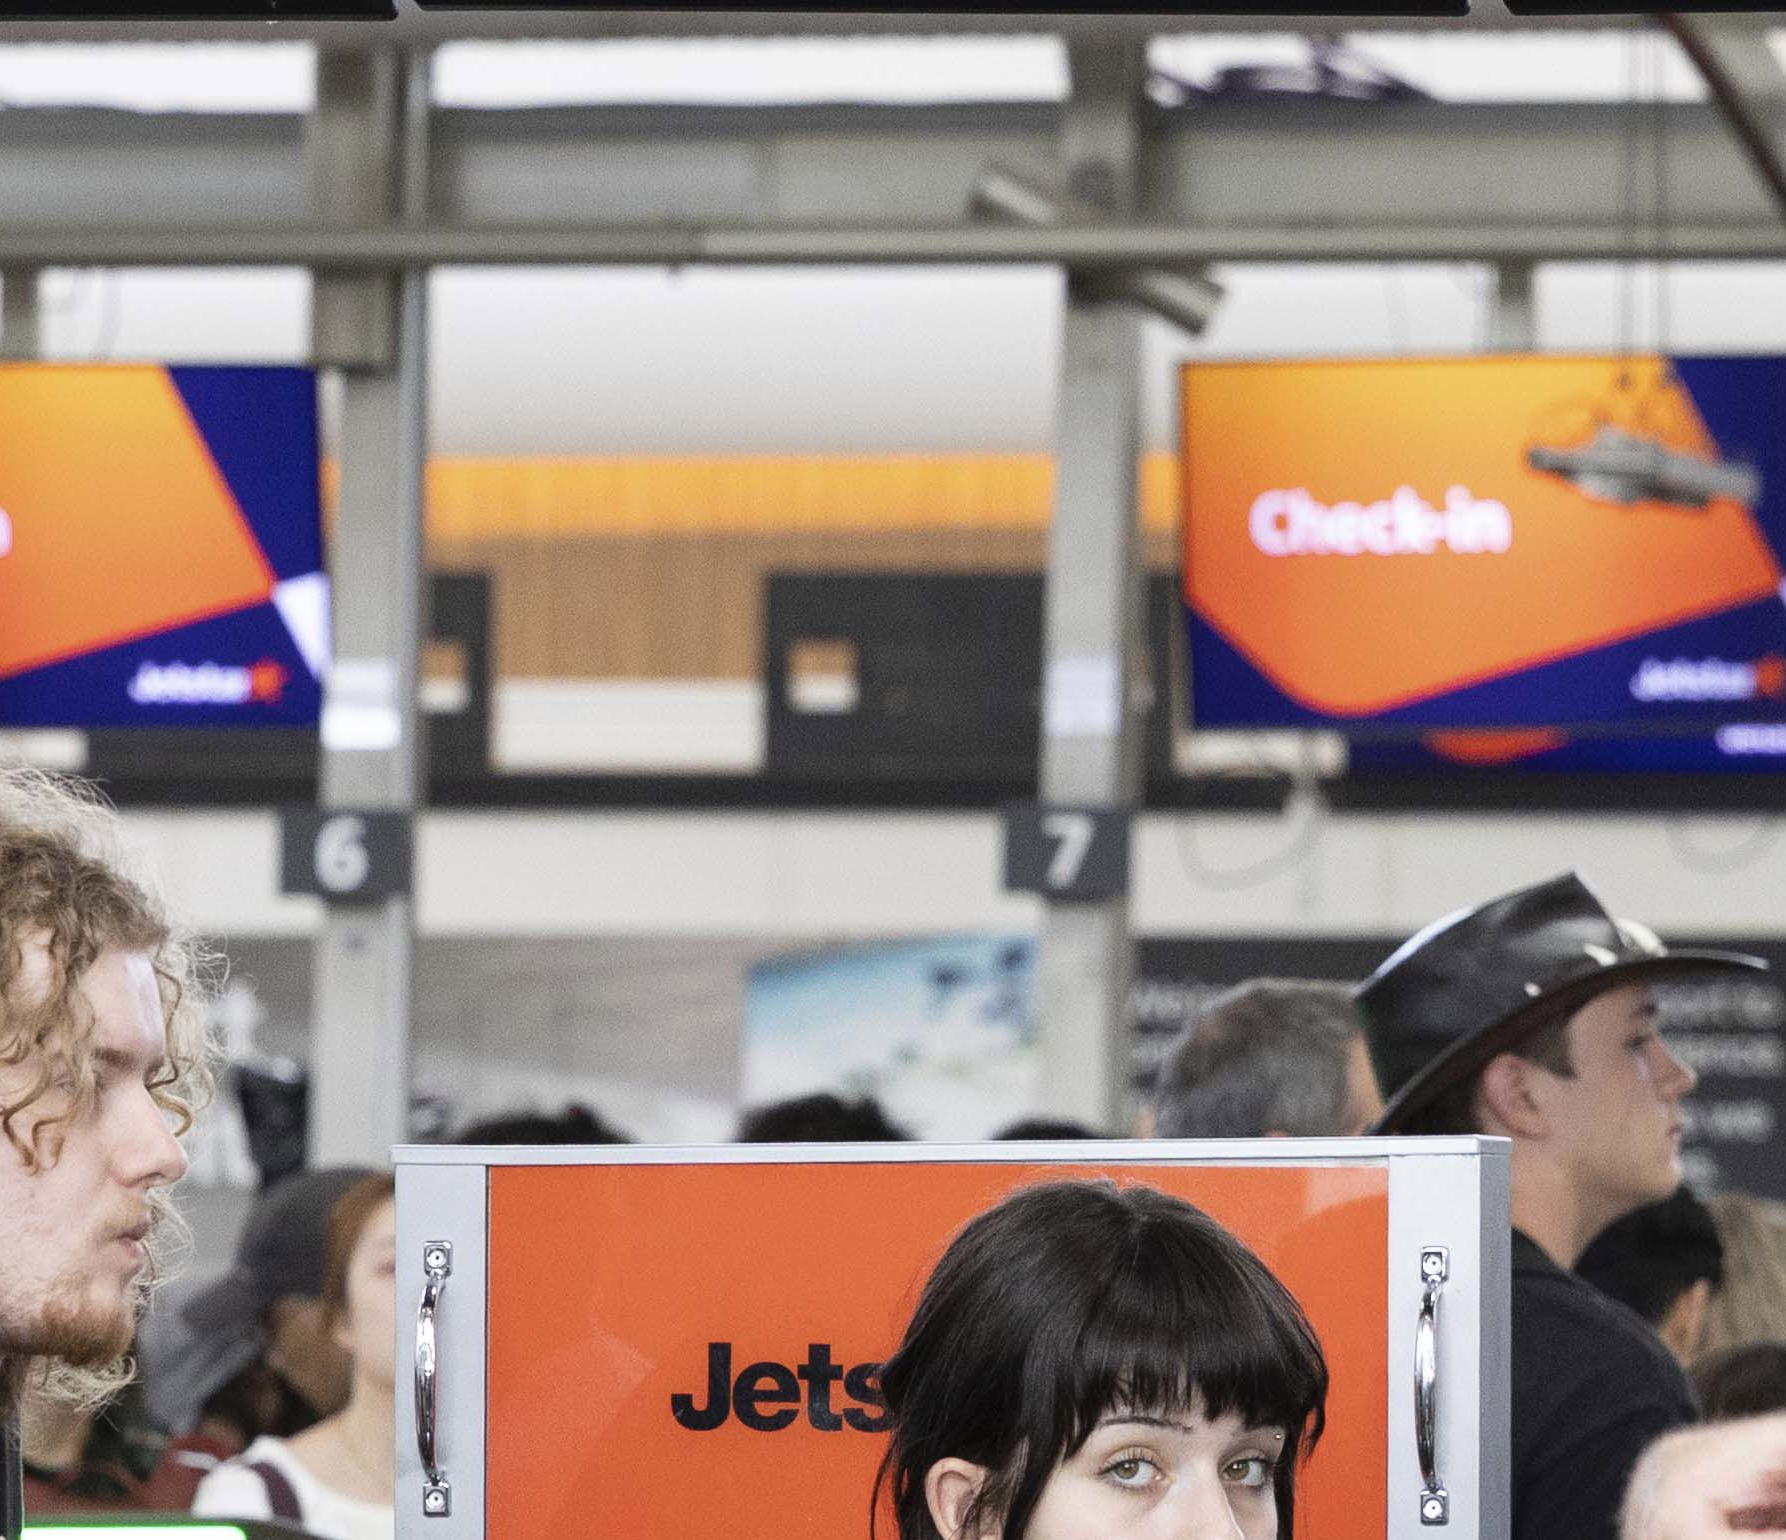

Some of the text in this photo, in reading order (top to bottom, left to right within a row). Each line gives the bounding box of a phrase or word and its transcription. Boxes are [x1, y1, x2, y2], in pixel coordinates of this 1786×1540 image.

[1248, 485, 1514, 556] Check-in
[315, 816, 368, 891] 6
[1045, 814, 1094, 885] 7
